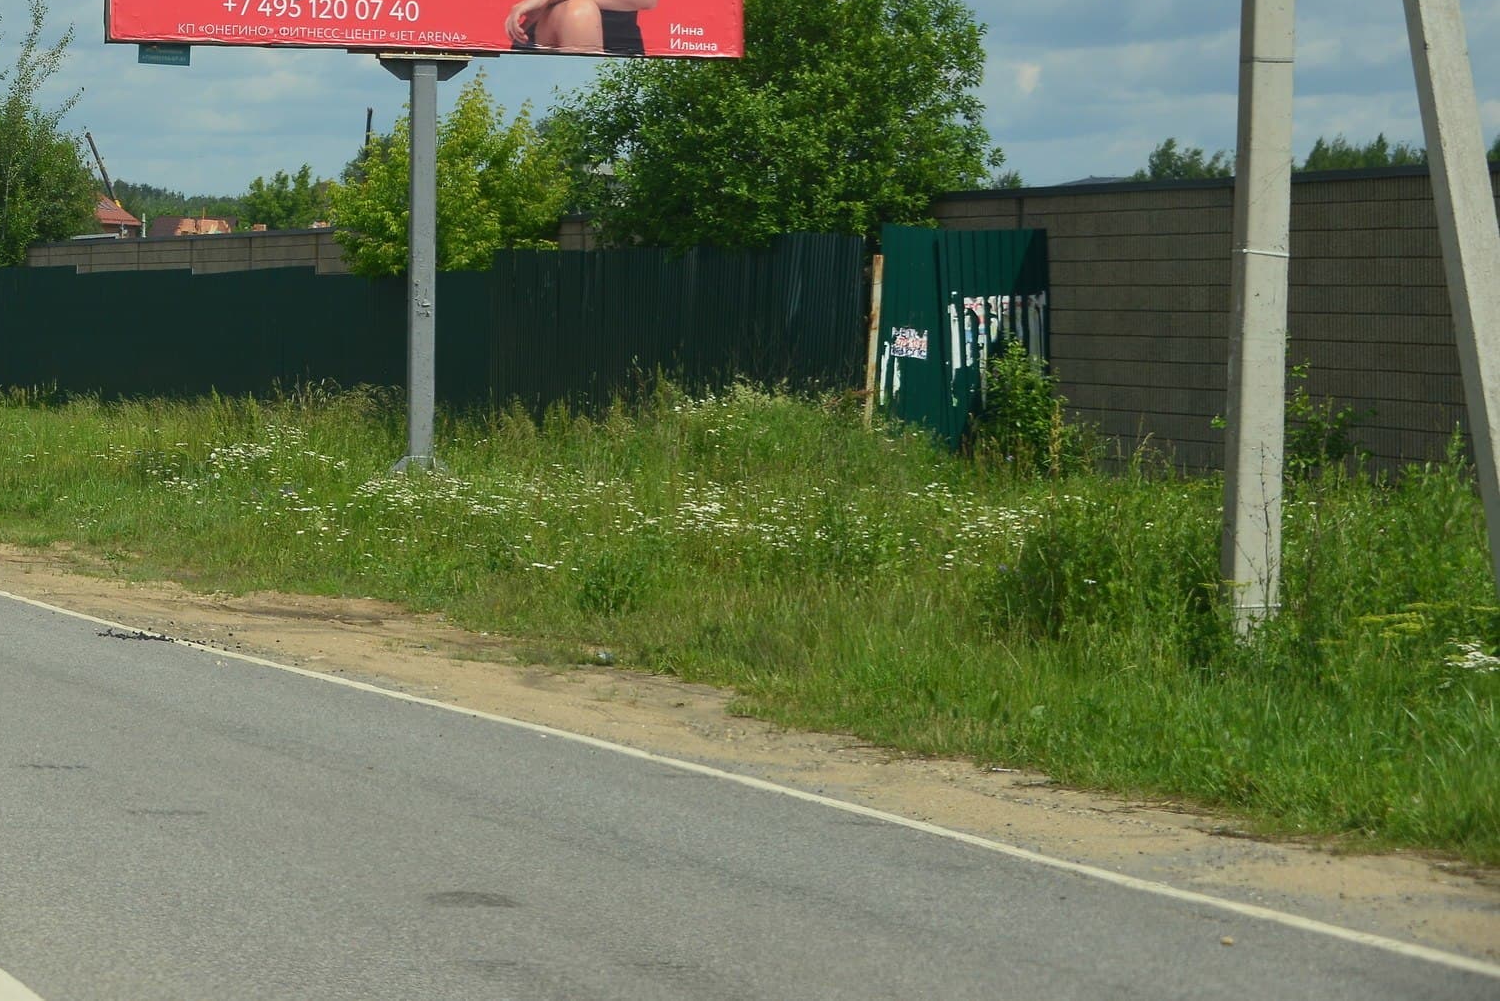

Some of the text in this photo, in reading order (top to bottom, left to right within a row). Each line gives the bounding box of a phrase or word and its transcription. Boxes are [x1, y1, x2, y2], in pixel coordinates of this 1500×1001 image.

[355, 0, 383, 20] 07
[389, 0, 419, 21] 40
[178, 23, 195, 34] КП
[279, 26, 387, 41] ФИТНЕСС-ЦЕНТР
[390, 30, 416, 41] «JET
[418, 31, 467, 42] ARENA»
[670, 23, 704, 36] Инна
[670, 38, 718, 51] Ильина
